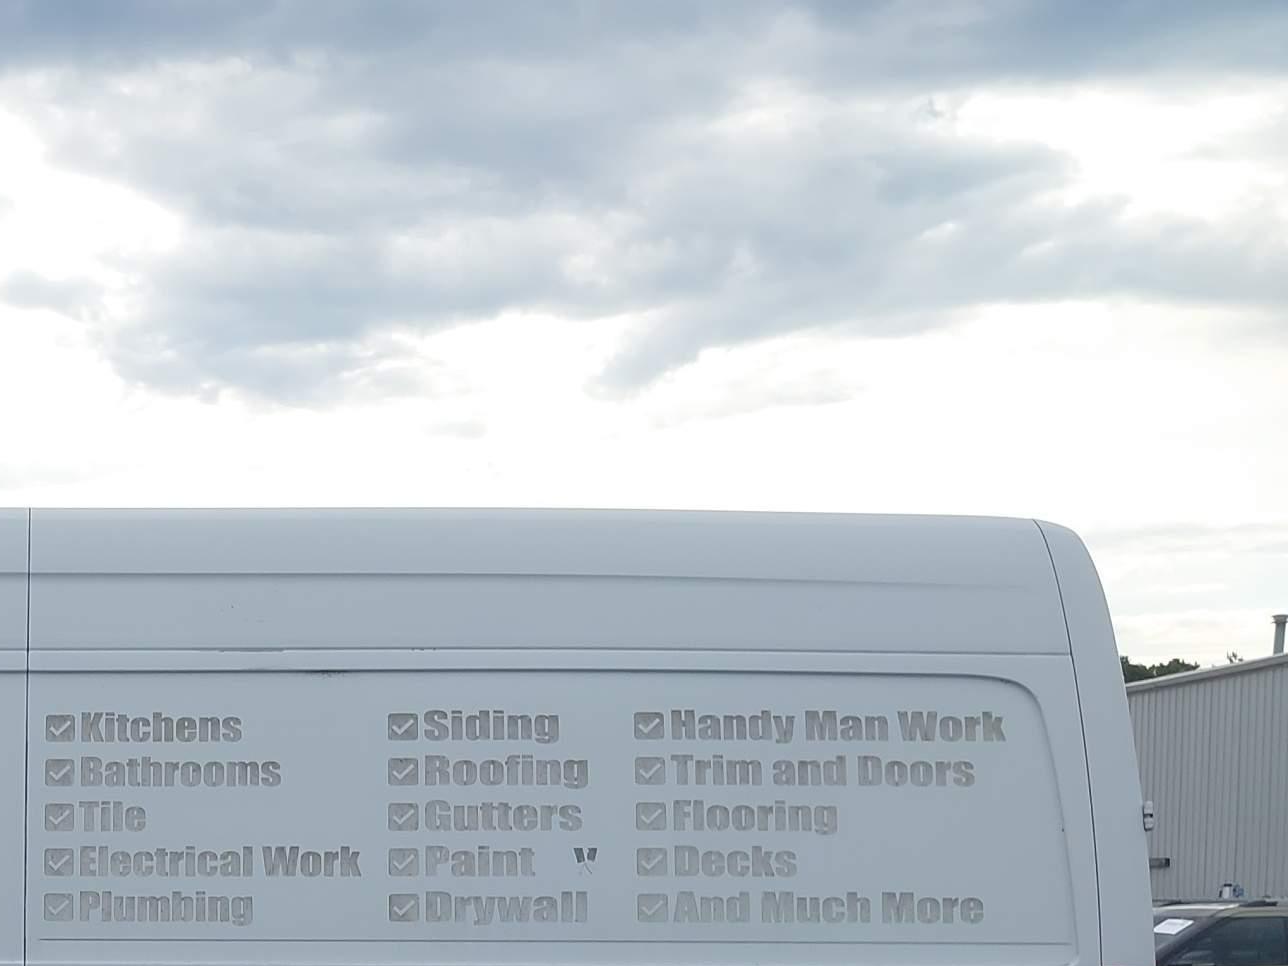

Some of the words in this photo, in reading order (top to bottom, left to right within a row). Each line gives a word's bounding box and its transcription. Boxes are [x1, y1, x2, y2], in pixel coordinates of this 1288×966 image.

[81, 712, 243, 742] Kitchens
[423, 710, 560, 744] Siding
[671, 710, 795, 744] Handy
[804, 710, 888, 742] Man
[898, 711, 1006, 742] Work
[81, 757, 282, 787] Bathrooms
[424, 755, 588, 789] Roofing
[671, 755, 762, 787] Trim
[772, 755, 847, 787] and
[858, 755, 975, 787] Doors
[78, 801, 146, 832] Tile
[424, 800, 583, 831] Gutters
[673, 800, 838, 835] Flooring
[80, 846, 253, 877] Electrical
[262, 846, 362, 877] Work
[425, 845, 536, 877] Paint
[674, 846, 796, 877] Decks
[80, 891, 253, 926] Plumbing
[425, 891, 588, 926] Drywall
[673, 892, 751, 923] And
[762, 892, 871, 923] Much
[881, 892, 984, 924] More
